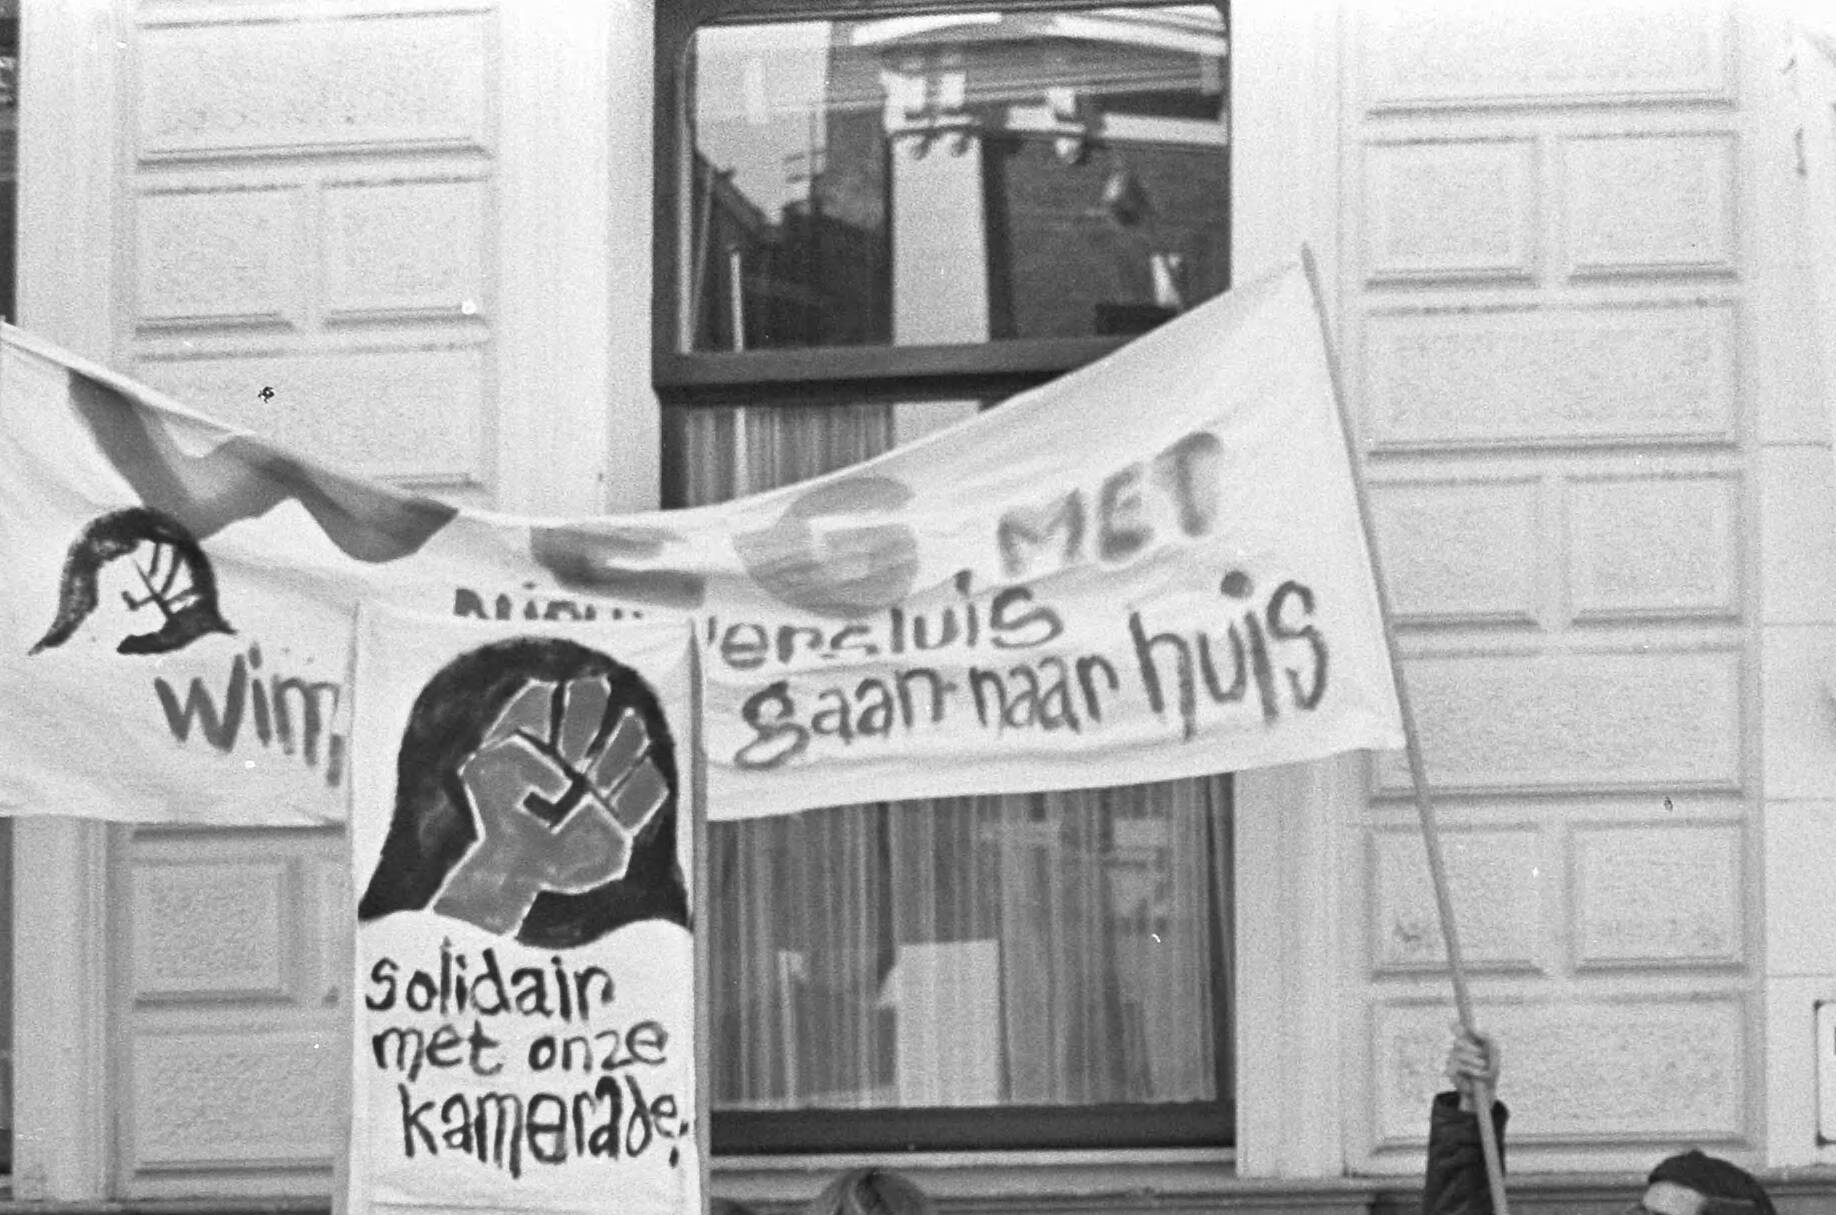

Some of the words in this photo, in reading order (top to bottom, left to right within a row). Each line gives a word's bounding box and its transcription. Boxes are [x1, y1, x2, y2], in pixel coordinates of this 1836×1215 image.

[997, 430, 1222, 562] MET
[706, 568, 1064, 673] ersluis
[733, 665, 955, 771] gaan
[968, 652, 1118, 733] naar
[1128, 569, 1329, 742] huis
[364, 937, 615, 1022] solidair
[371, 1020, 505, 1083] met
[527, 1020, 669, 1073] onze
